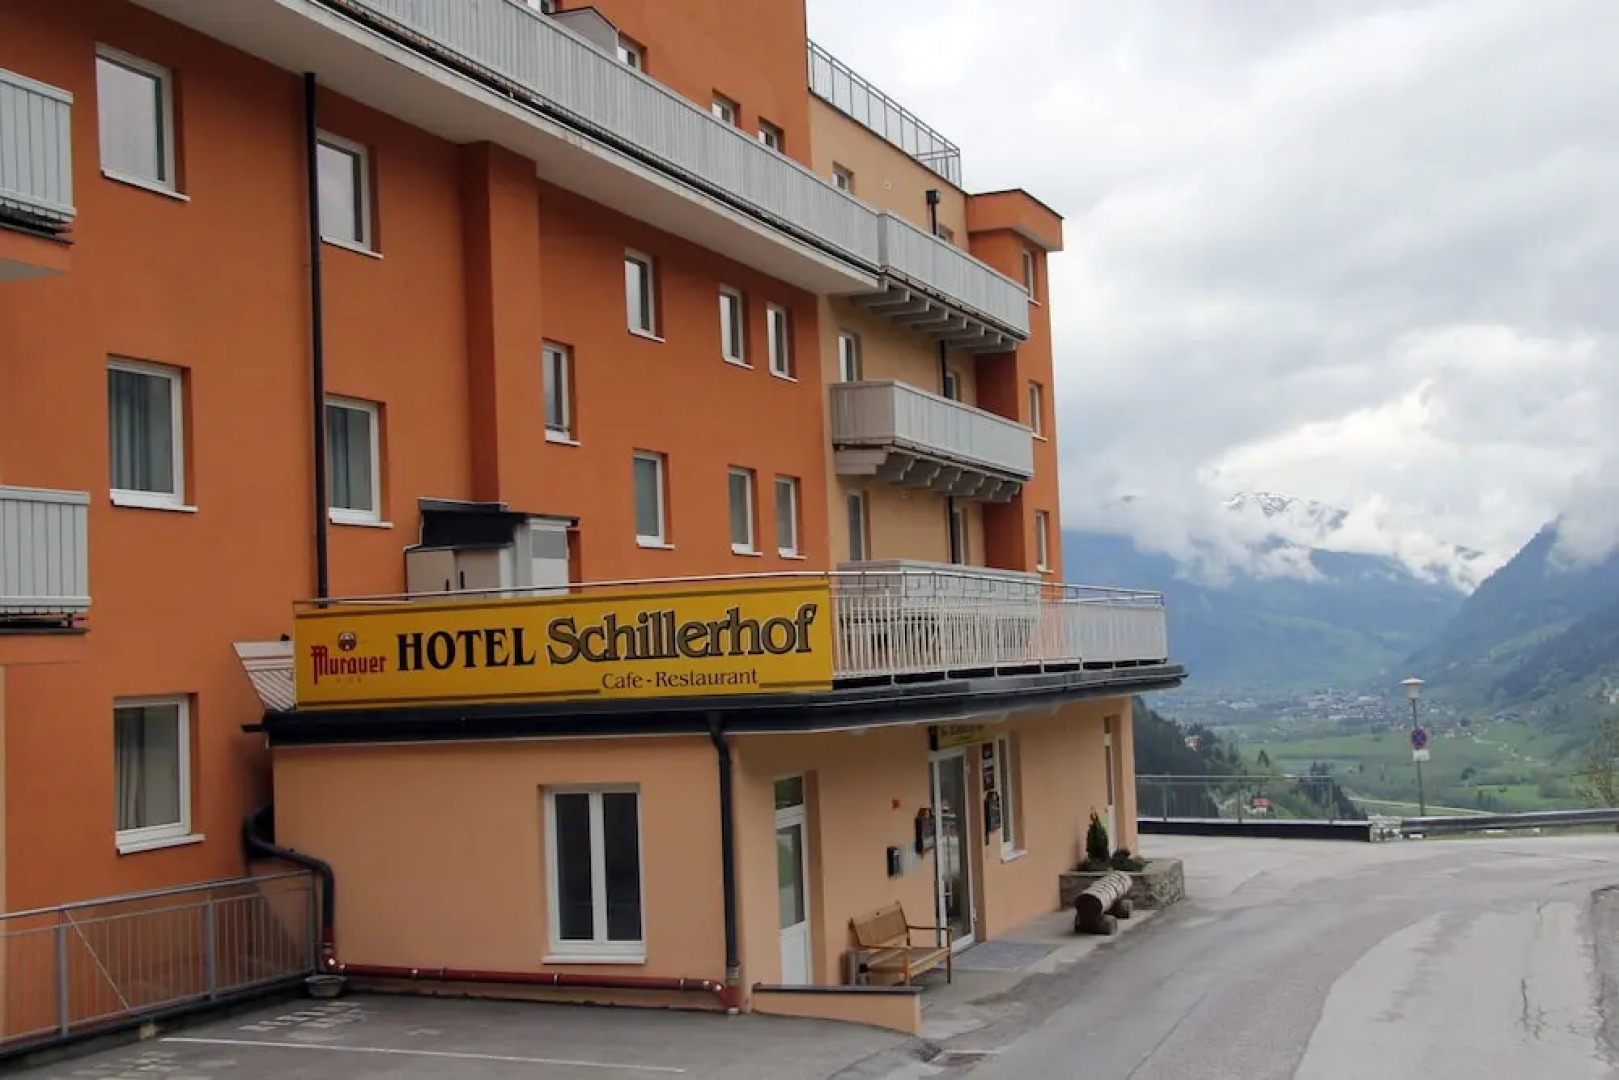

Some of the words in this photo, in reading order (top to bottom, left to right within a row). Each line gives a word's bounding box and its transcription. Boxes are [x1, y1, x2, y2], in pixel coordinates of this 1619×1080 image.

[396, 627, 536, 671] HOTEL
[547, 603, 818, 665] Schillerhof
[310, 645, 387, 685] Murauer
